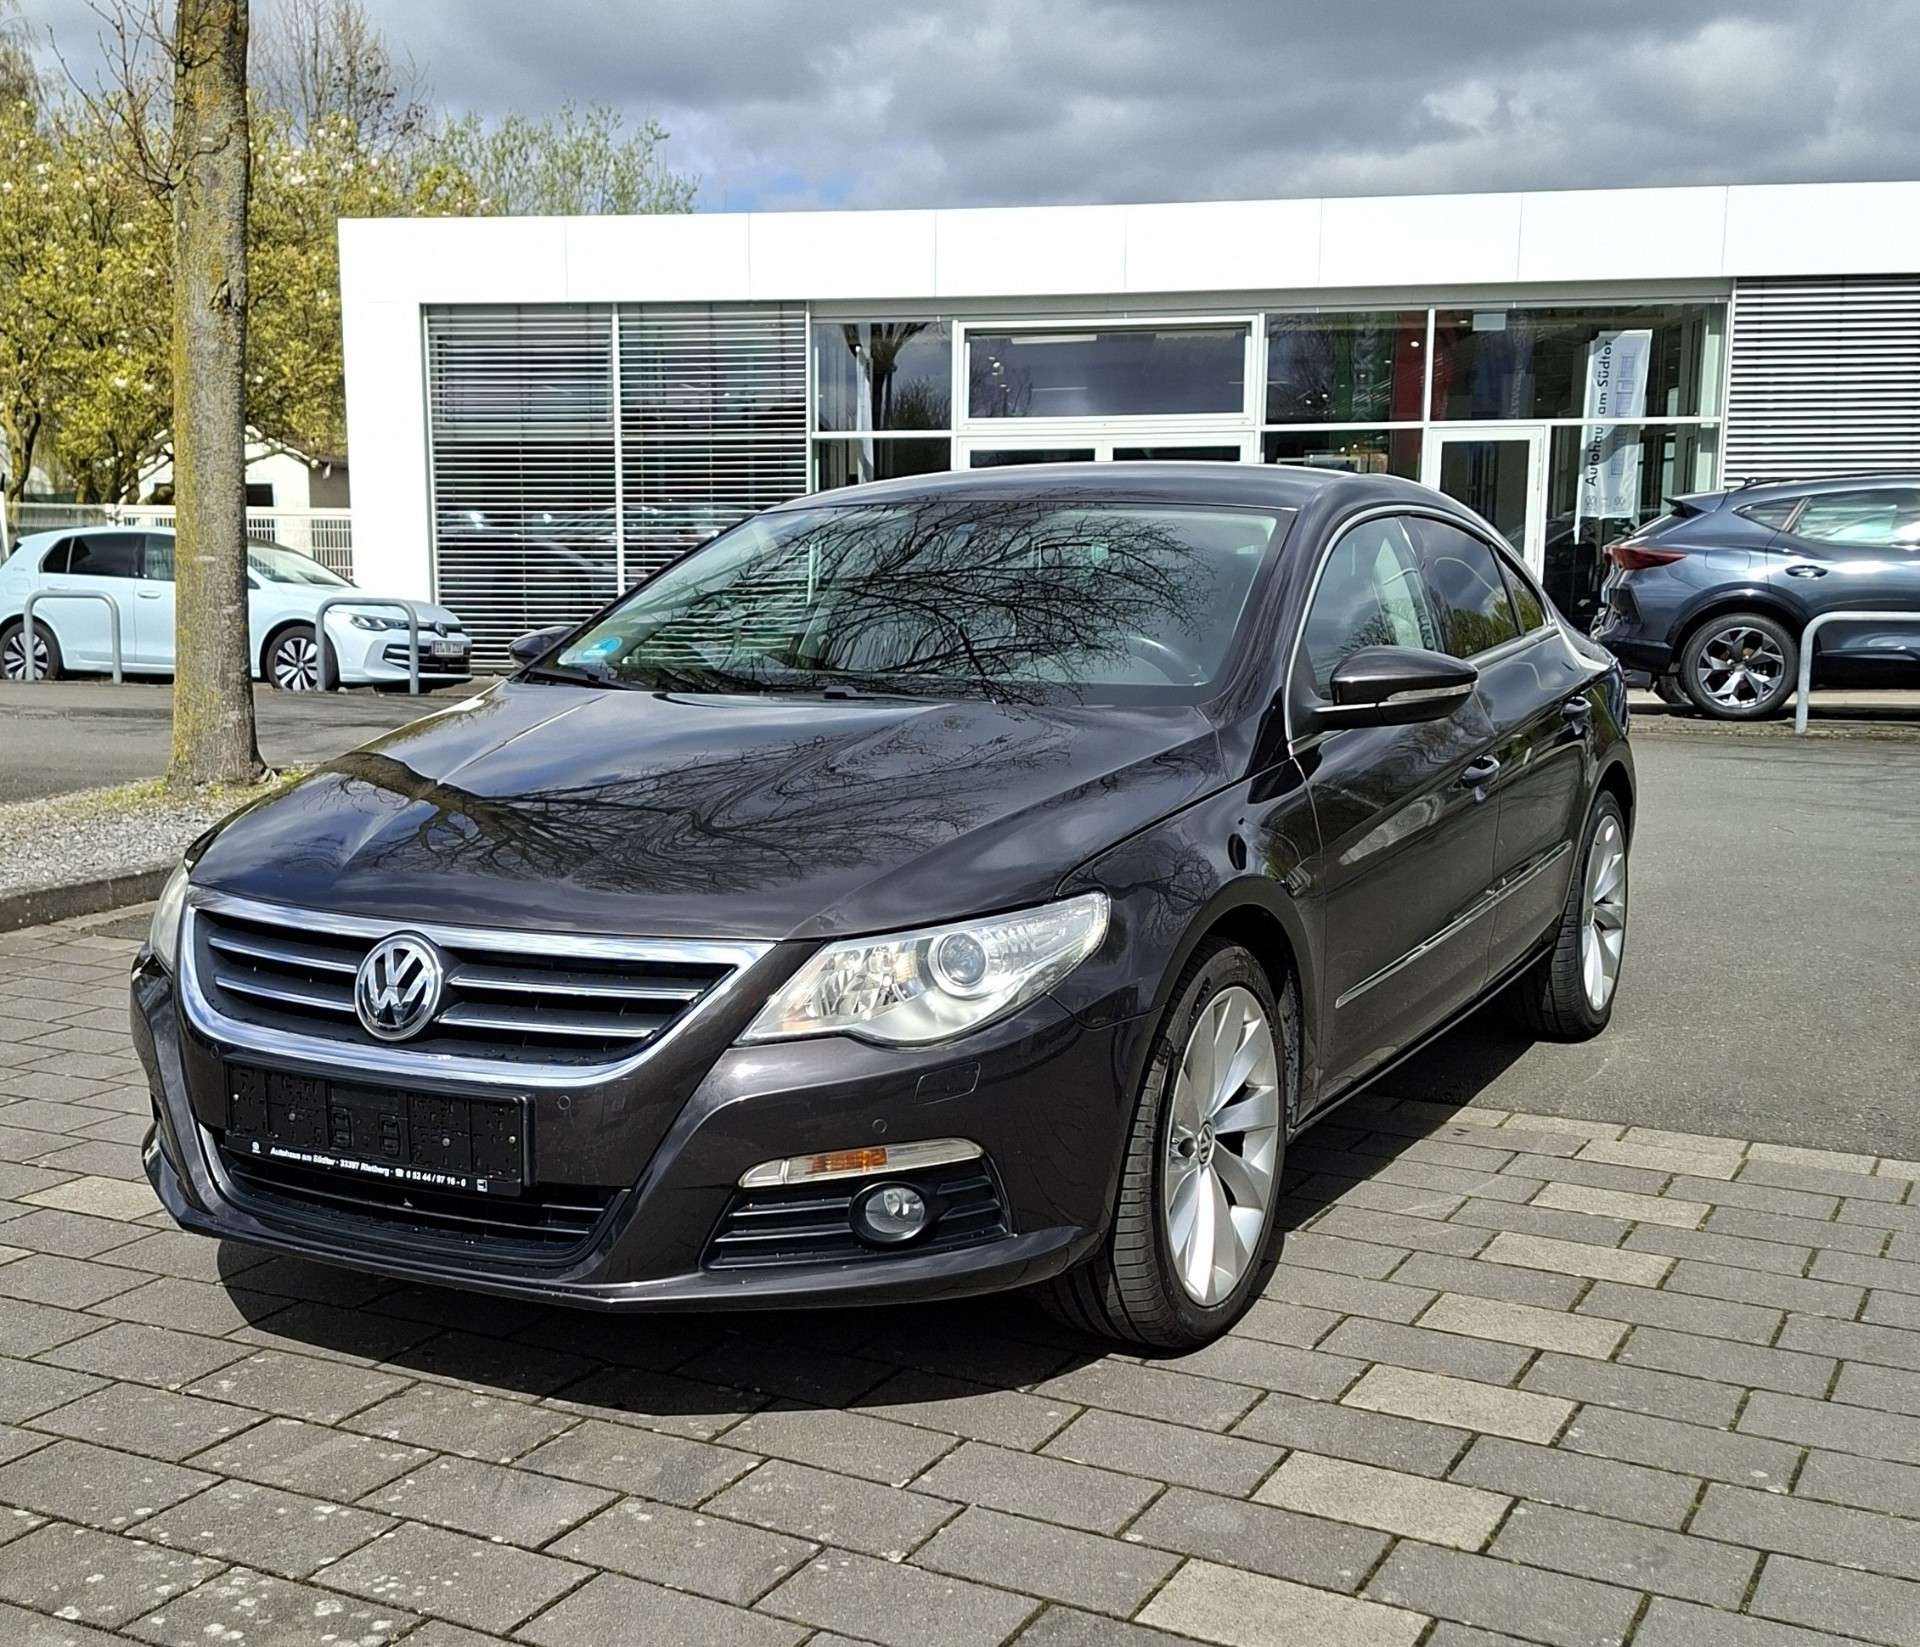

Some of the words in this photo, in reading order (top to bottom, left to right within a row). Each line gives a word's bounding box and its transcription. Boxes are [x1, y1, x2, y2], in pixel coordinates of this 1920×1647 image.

[1597, 340, 1612, 388] Südtor
[1598, 392, 1607, 415] am
[1585, 424, 1604, 487] Autohau
[357, 939, 437, 1034] VW
